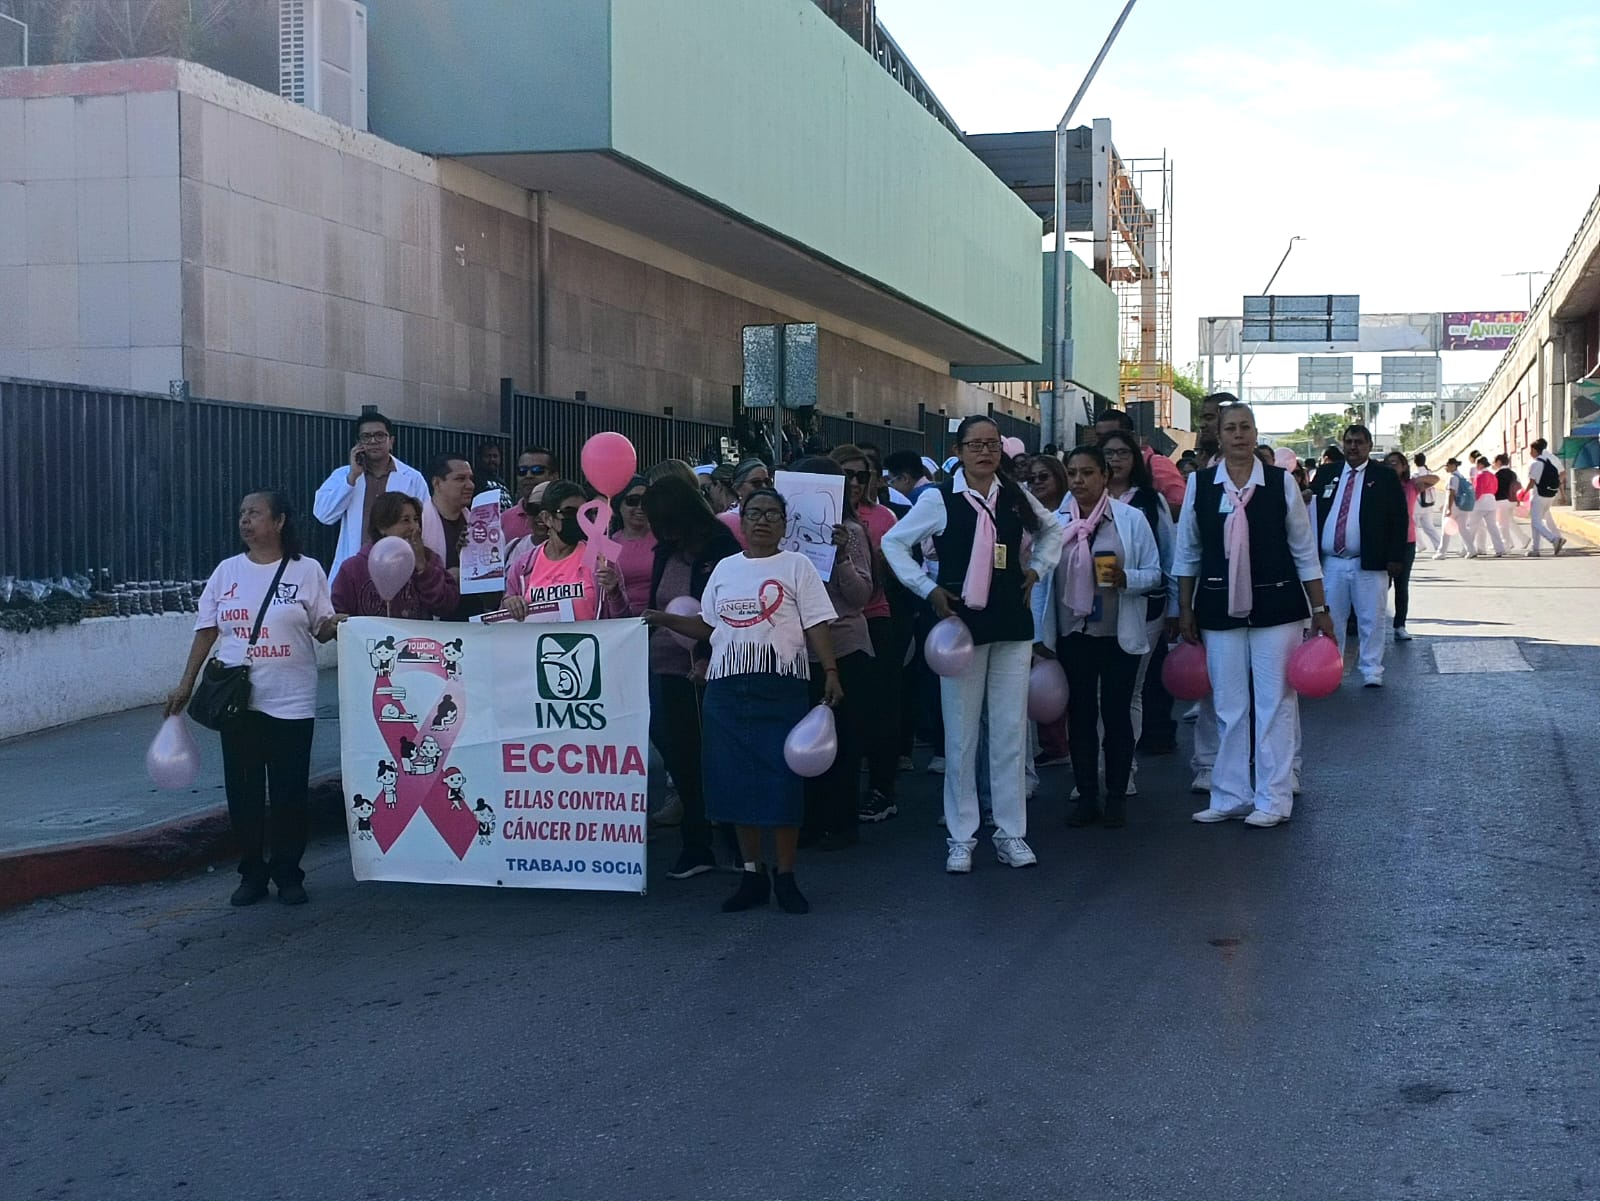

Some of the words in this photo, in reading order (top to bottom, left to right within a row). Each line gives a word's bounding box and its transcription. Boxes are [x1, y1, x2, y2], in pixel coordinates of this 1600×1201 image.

[530, 587, 545, 602] VA
[547, 584, 571, 601] POR
[221, 608, 249, 622] AMOR
[246, 645, 291, 658] CORAJE
[535, 702, 607, 730] IMSS
[502, 743, 646, 776] ECCMA
[504, 789, 554, 809] ELLAS
[558, 790, 627, 811] CONTRA
[631, 792, 646, 812] EL
[502, 816, 571, 841] CÁNCER
[575, 822, 598, 841] DE
[600, 823, 645, 844] MAM
[506, 858, 586, 873] TRABAJO
